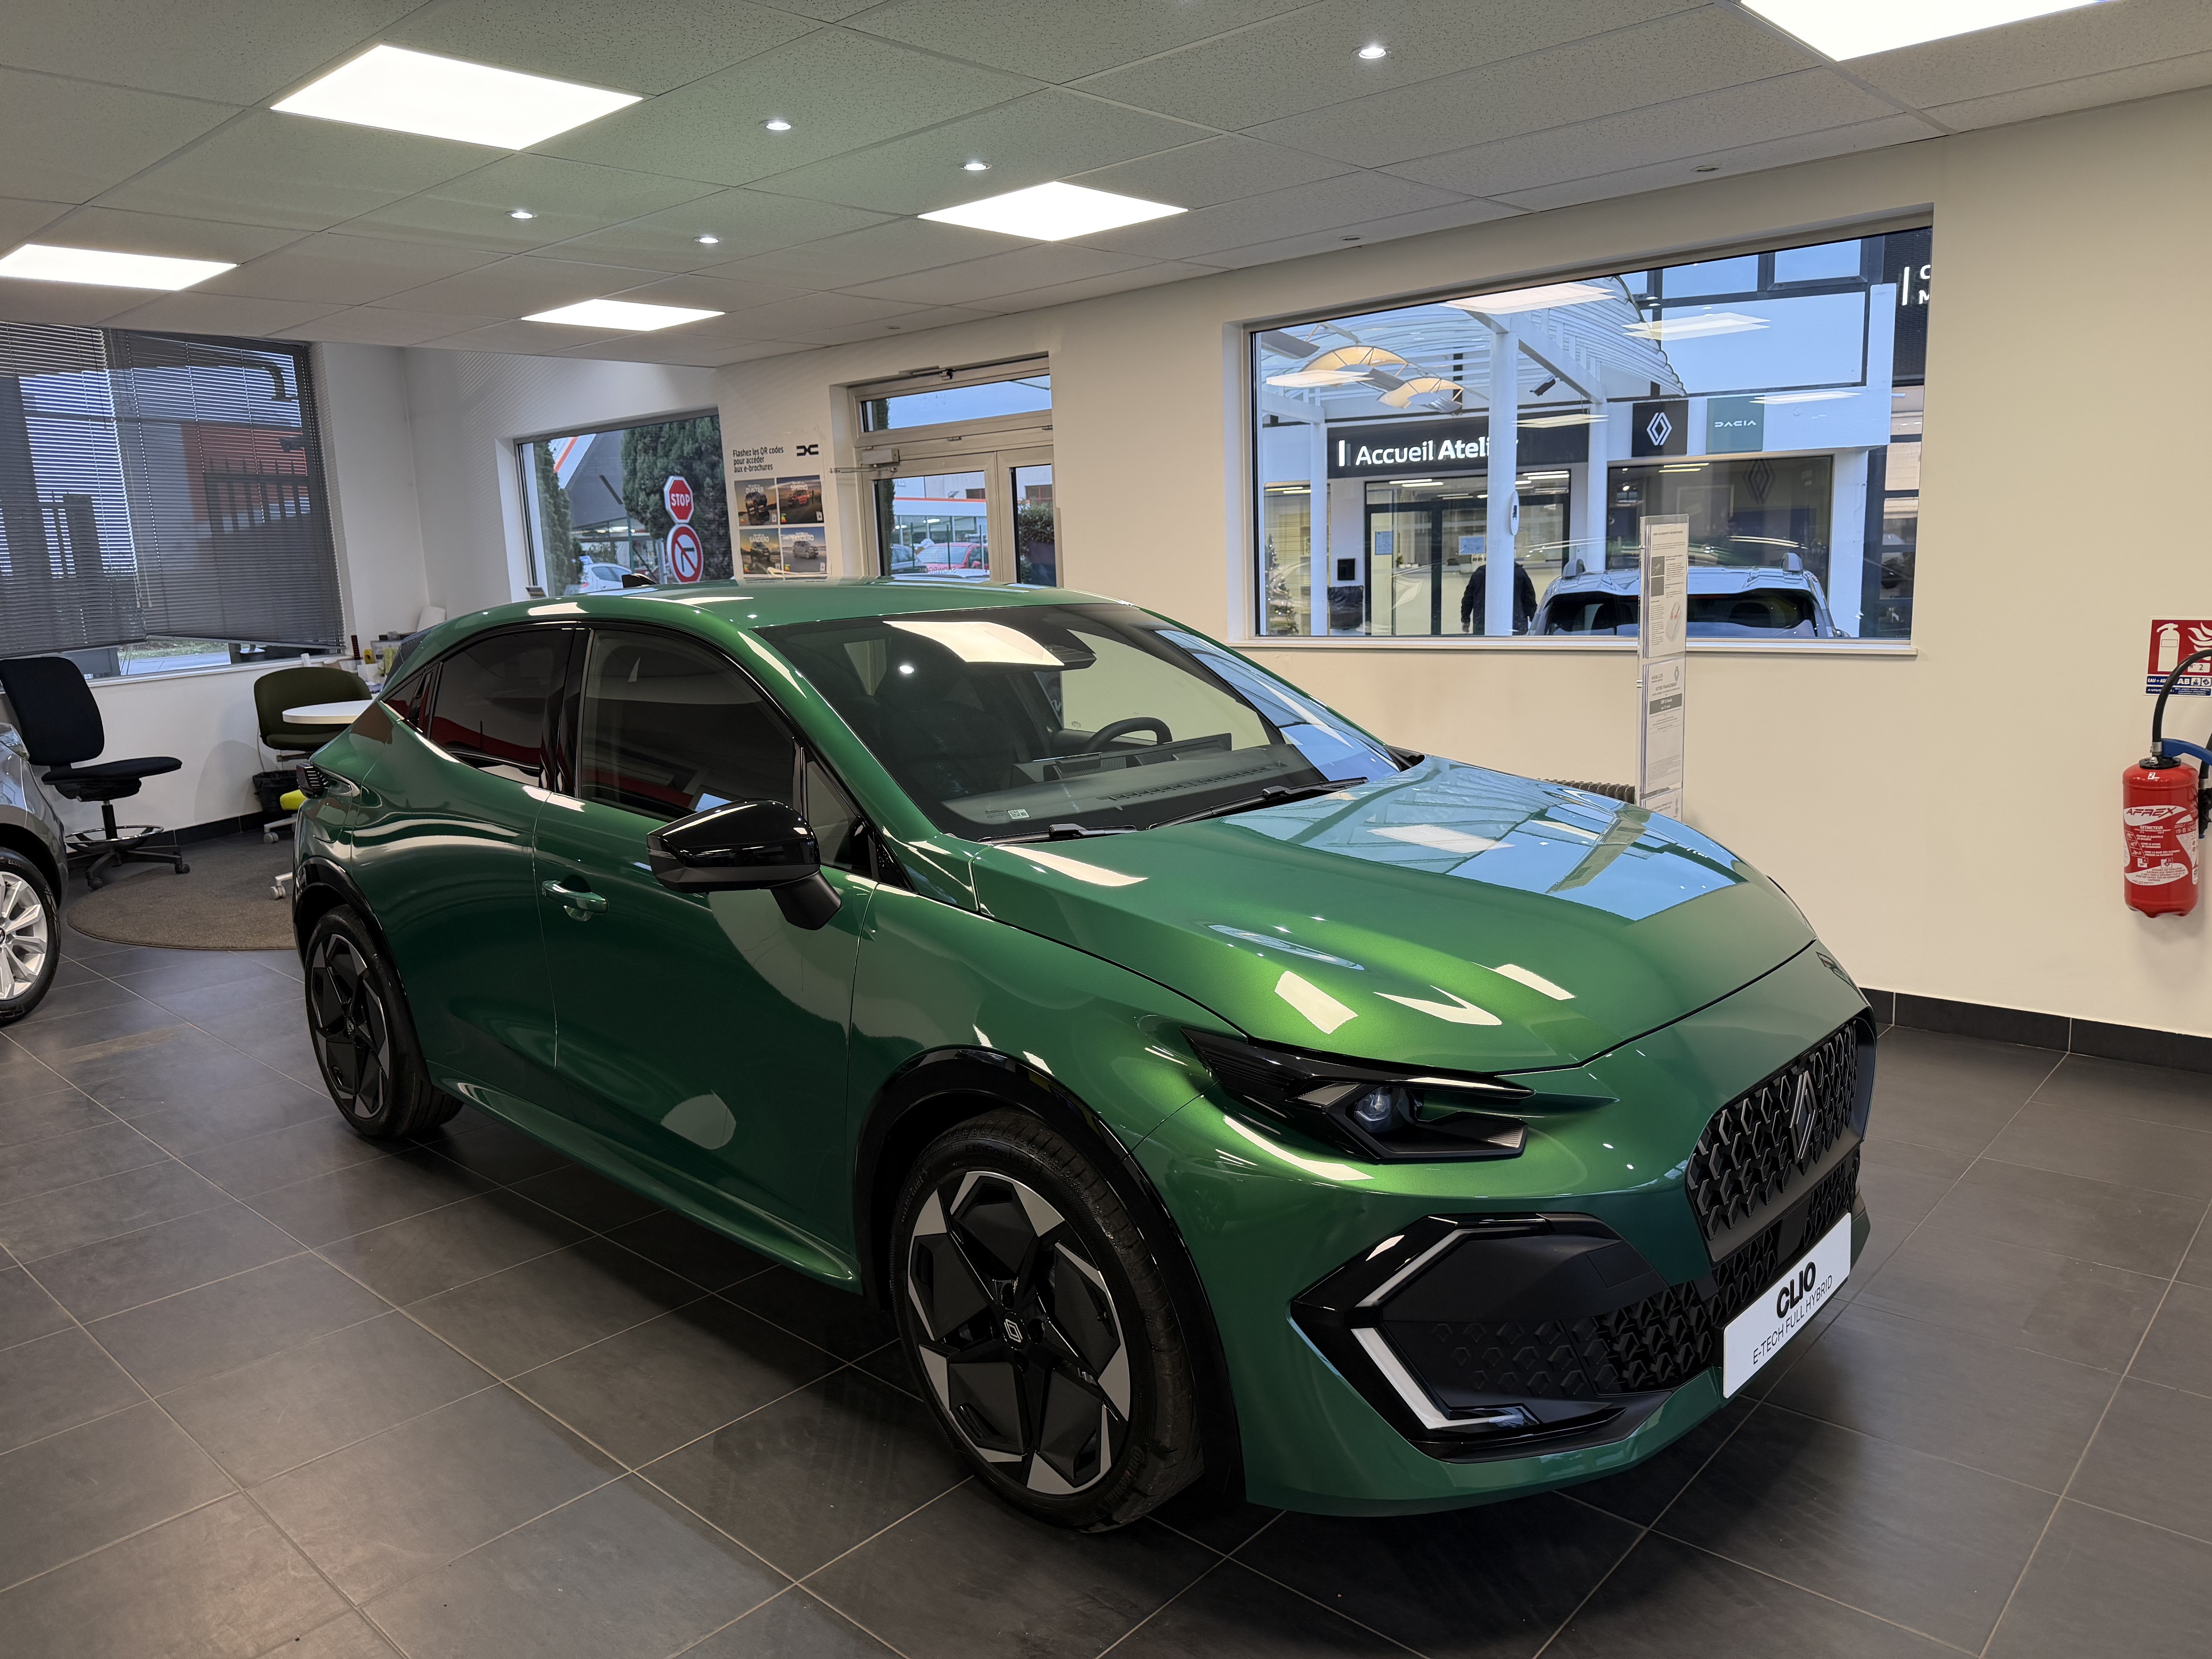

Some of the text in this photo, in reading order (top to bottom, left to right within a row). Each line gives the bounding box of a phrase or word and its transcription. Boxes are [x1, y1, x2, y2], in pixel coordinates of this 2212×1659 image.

[1920, 264, 1931, 280] C
[1919, 289, 1930, 304] M
[733, 449, 752, 457] Flashez
[760, 447, 768, 456] QR
[1355, 436, 1518, 465] Accueil Ateli
[734, 455, 764, 467] pour accéder
[744, 464, 773, 472] e-brochures
[670, 493, 690, 507] STOP
[1776, 1261, 1816, 1319] CLIO
[1753, 1274, 1832, 1365] E-TECH FULL HYBRID
